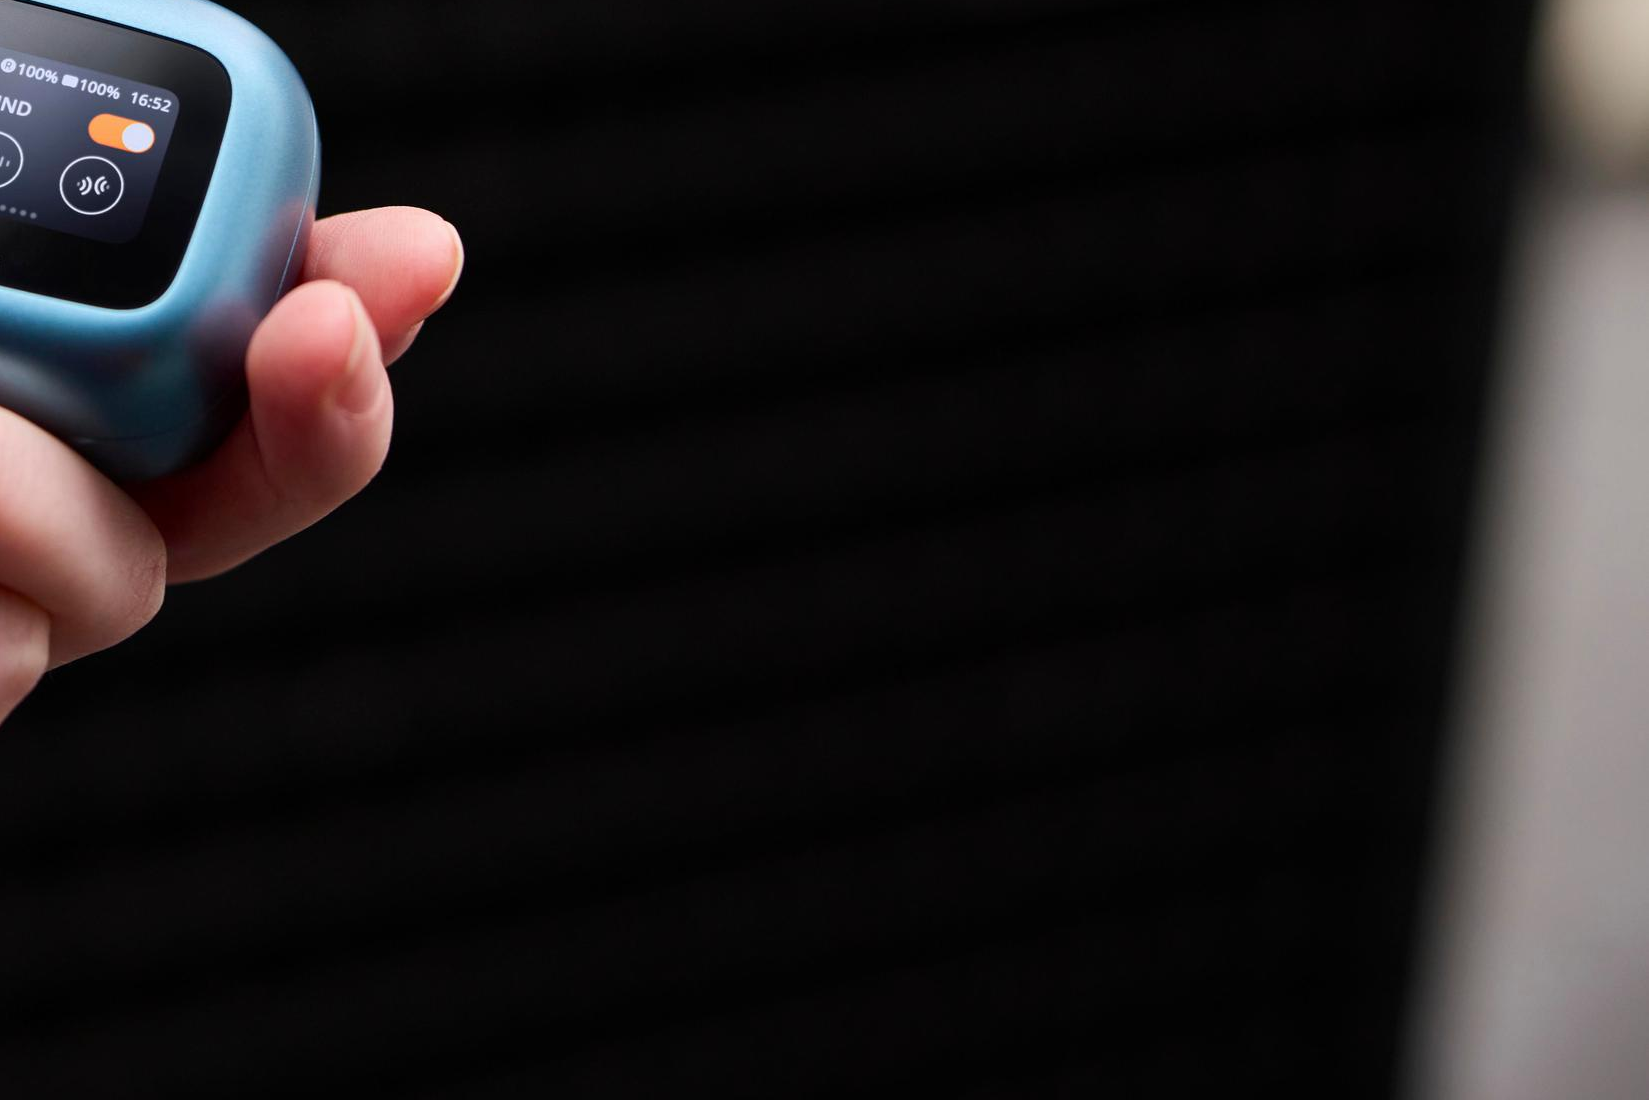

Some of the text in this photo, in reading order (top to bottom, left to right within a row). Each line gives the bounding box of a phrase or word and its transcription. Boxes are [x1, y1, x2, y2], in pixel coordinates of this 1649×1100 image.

[18, 63, 58, 84] 100%
[80, 79, 120, 100] 100%
[131, 92, 172, 112] 16:52
